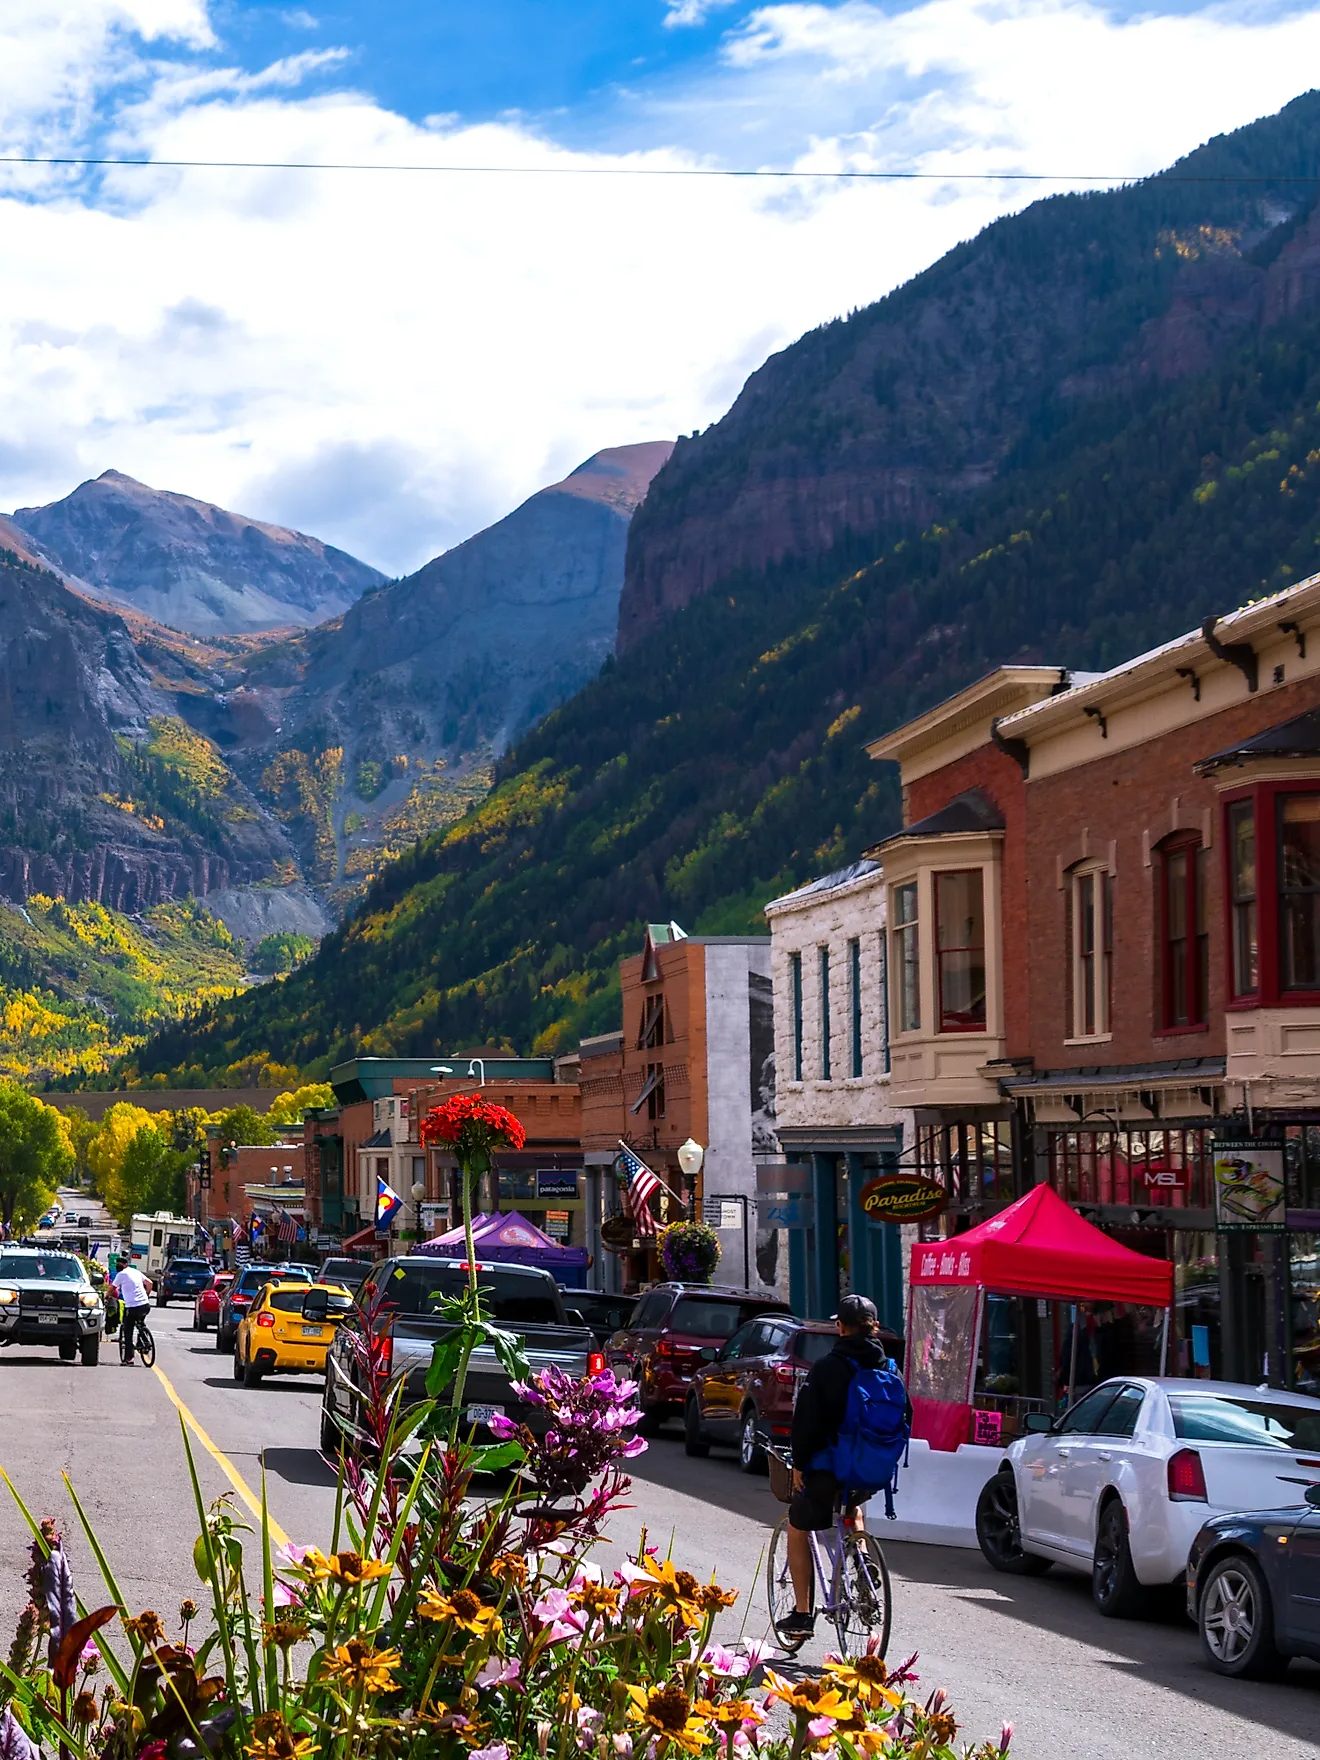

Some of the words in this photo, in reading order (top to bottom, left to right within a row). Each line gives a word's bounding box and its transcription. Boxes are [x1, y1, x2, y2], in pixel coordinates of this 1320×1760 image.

[1144, 1172, 1185, 1186] MSL
[539, 1185, 576, 1194] patagonia
[864, 1187, 943, 1211] Paradise
